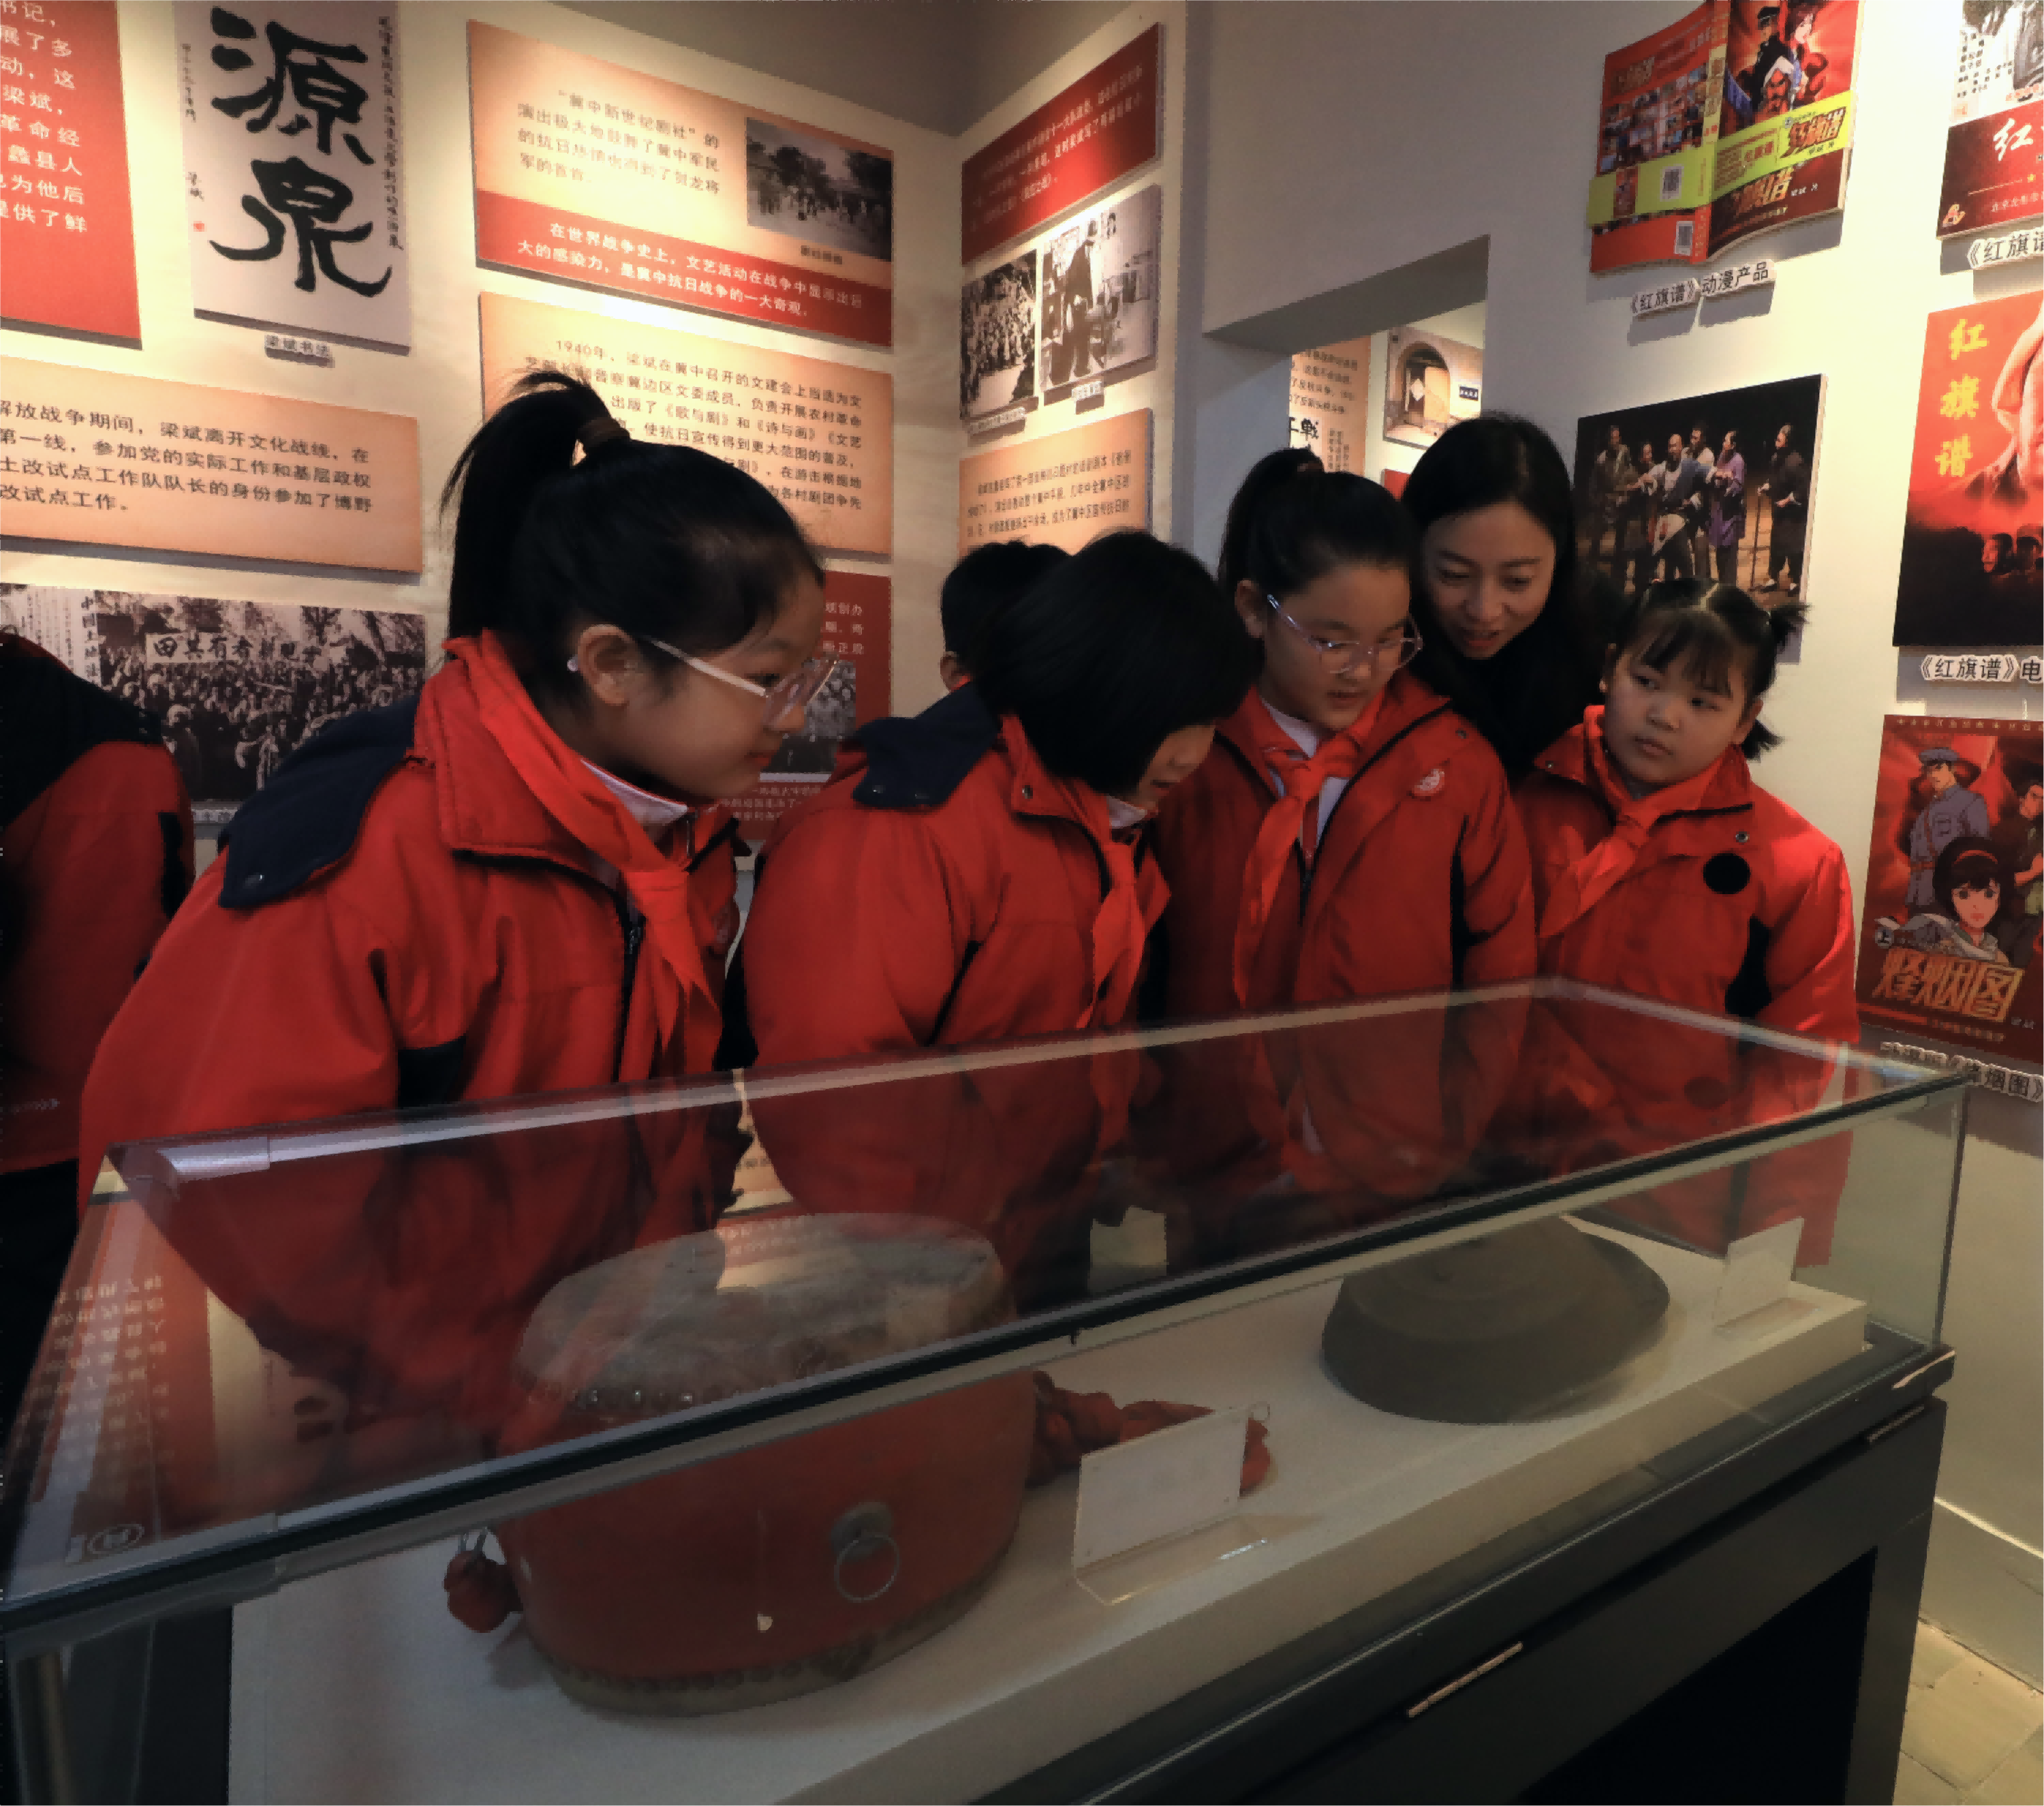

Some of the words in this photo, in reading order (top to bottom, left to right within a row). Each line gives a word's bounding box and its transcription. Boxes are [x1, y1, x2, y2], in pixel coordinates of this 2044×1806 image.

[210, 6, 392, 298] 源泉
[1935, 319, 1989, 477] 红旗谱
